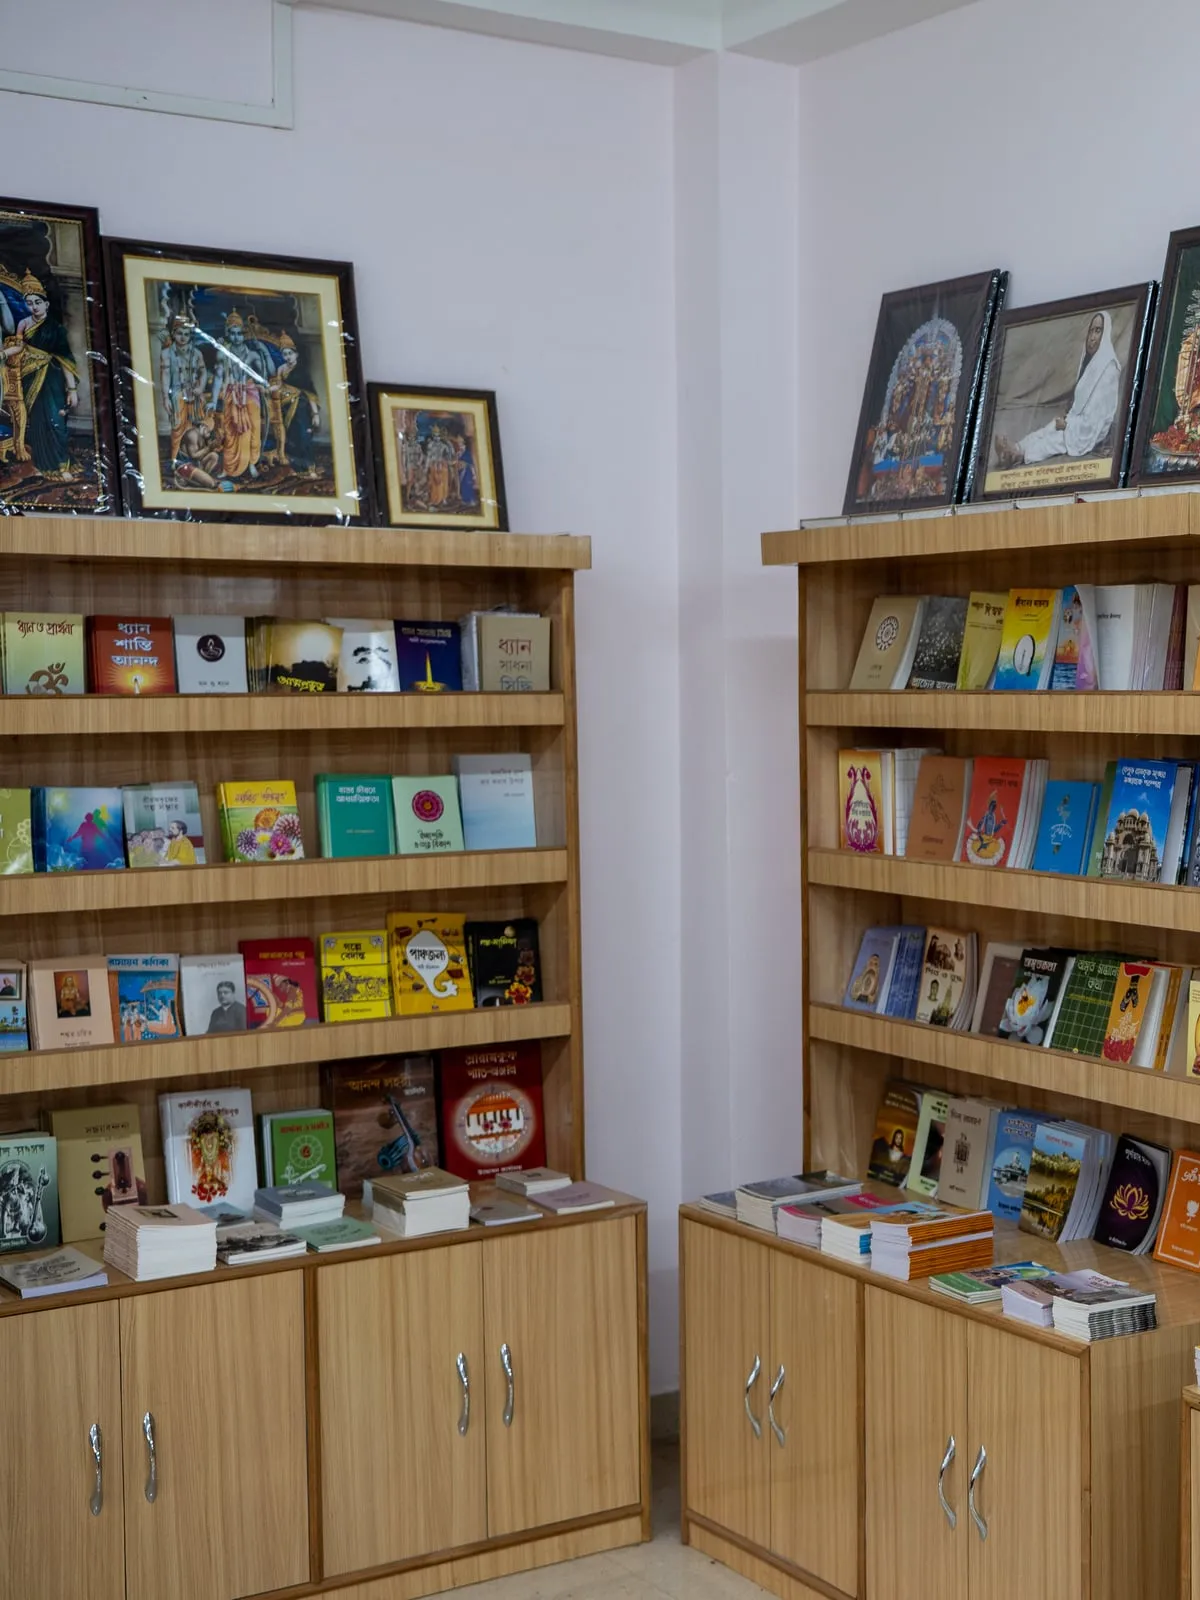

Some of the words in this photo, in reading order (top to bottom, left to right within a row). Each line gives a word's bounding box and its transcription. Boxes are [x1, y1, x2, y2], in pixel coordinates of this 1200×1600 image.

[36, 622, 44, 633] ও
[117, 622, 152, 635] ধ্যান
[114, 636, 154, 652] শান্তি
[499, 638, 532, 656] ধ্যান
